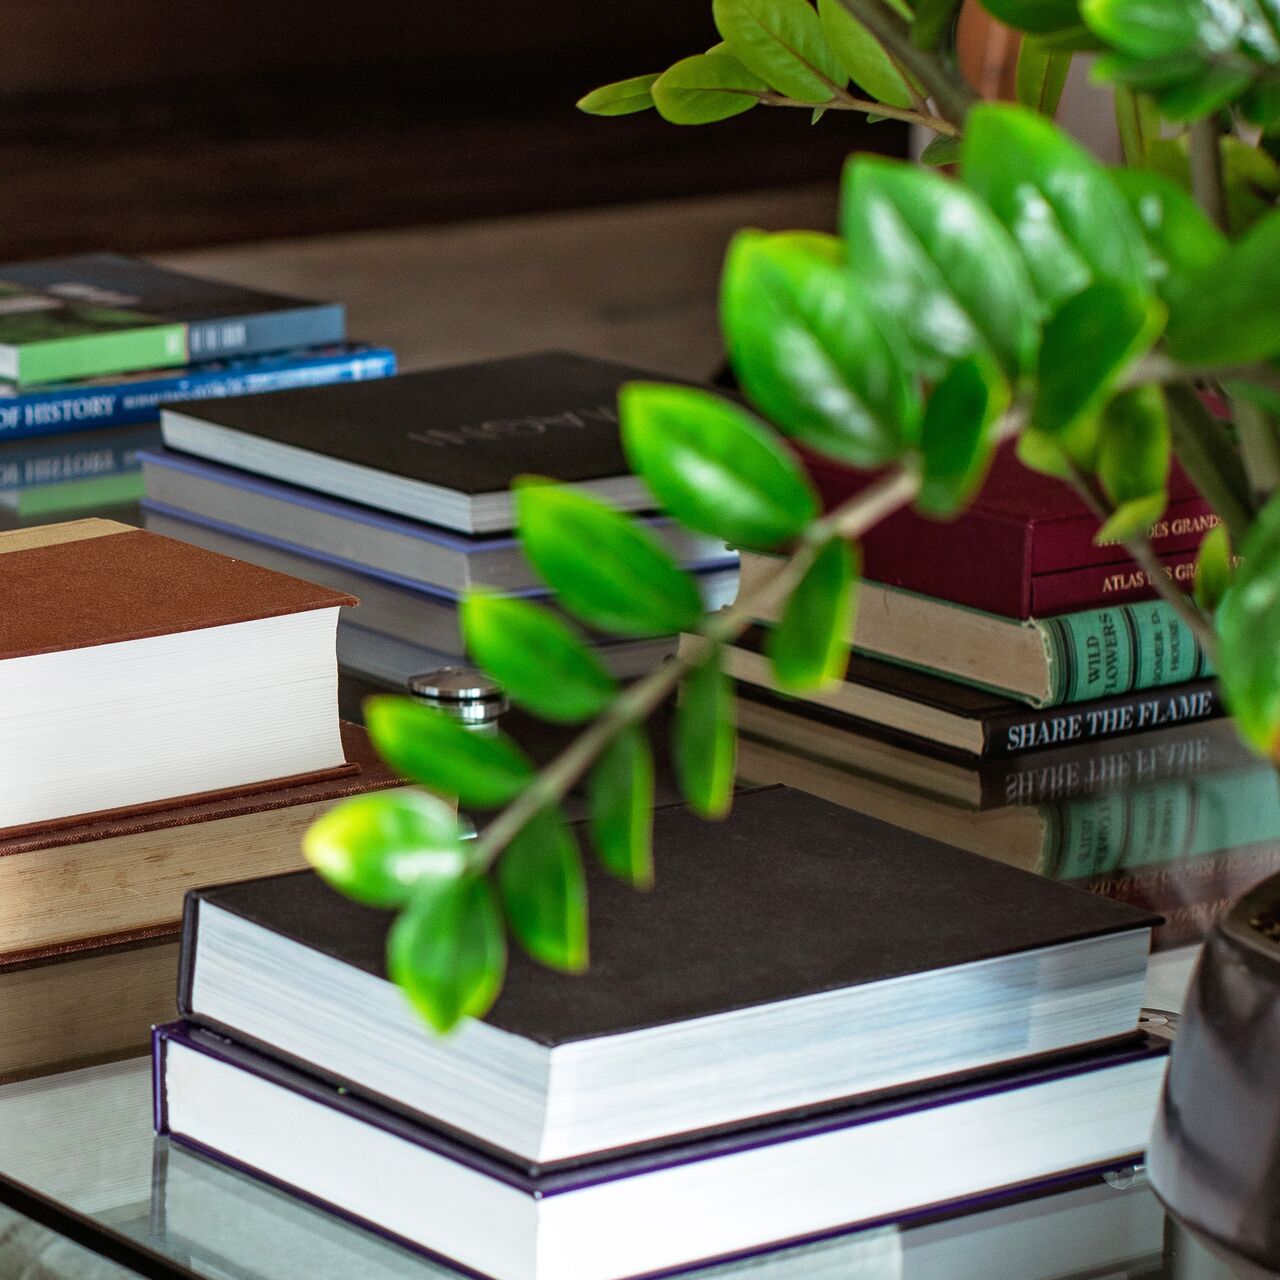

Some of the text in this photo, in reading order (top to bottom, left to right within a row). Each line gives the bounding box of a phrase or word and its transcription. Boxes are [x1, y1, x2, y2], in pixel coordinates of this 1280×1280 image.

[24, 393, 116, 427] HISTORY
[1102, 570, 1146, 593] ATLAS
[1086, 635, 1101, 685] WILD
[1006, 690, 1213, 751] SHARE THE FLAME
